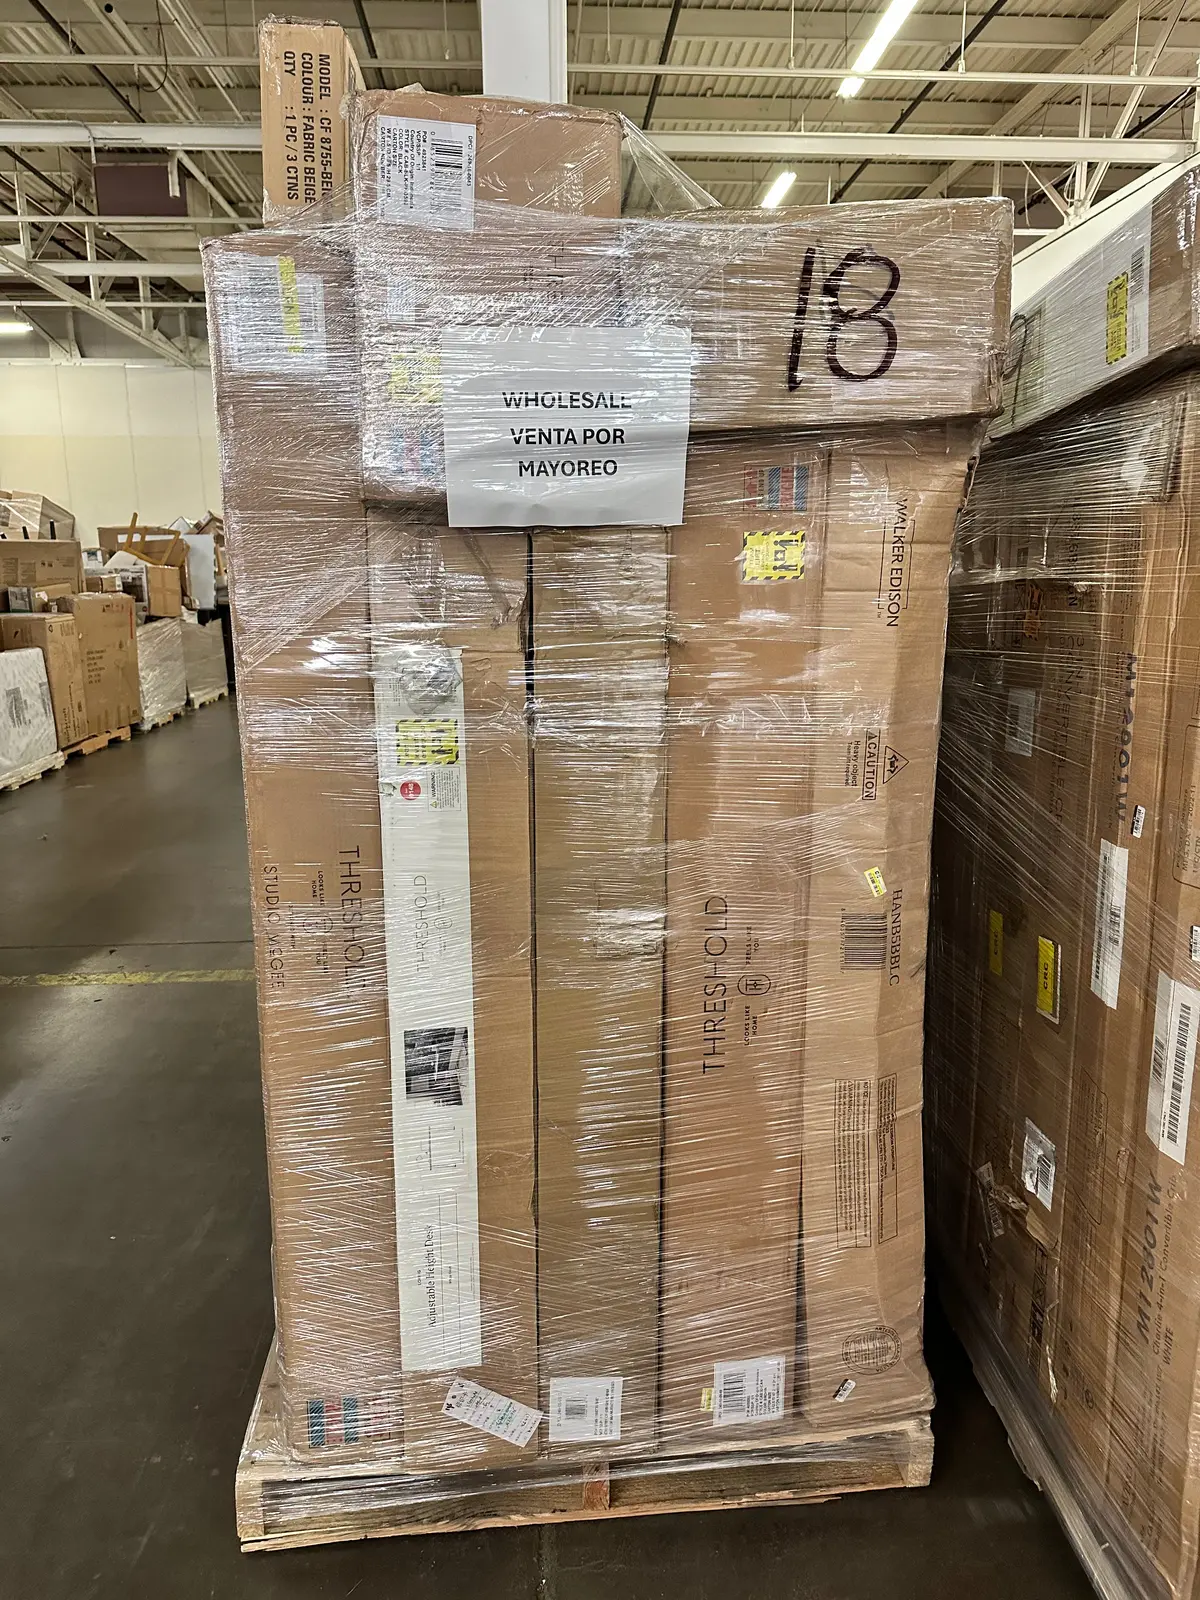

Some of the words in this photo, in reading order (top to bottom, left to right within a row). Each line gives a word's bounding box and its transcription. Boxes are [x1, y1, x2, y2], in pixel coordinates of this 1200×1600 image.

[284, 50, 296, 76] QTY
[301, 52, 314, 104] COLOUR
[319, 54, 331, 100] MODEL
[286, 125, 297, 142] PC
[302, 115, 315, 162] FABRIC
[319, 117, 331, 133] CF
[286, 154, 298, 162] 3
[286, 166, 299, 200] CTNS
[303, 167, 316, 204] BEIGE
[787, 243, 901, 392] 18
[502, 391, 632, 409] WHOLESALE
[510, 427, 577, 445] VENTA
[582, 427, 625, 445] POR
[518, 459, 618, 477] MAYOREO
[891, 498, 908, 564] WALKER
[886, 568, 903, 627] EDISON
[852, 740, 861, 762] Heavy
[864, 742, 877, 798] CAUTION
[851, 764, 859, 787] object
[263, 866, 280, 924] STUDIO
[413, 875, 430, 972] THRESHOLD
[889, 888, 903, 986] HANB5BBLC
[702, 895, 728, 1074] THRESHOLD
[1166, 1175, 1177, 1199] Crib
[1159, 1204, 1174, 1272] Convertible
[425, 1249, 437, 1279] Height
[426, 1281, 438, 1327] Adjustable
[1156, 1276, 1166, 1311] 4-in-1
[1152, 1315, 1164, 1355] Charlie
[1162, 1327, 1174, 1365] WHITE
